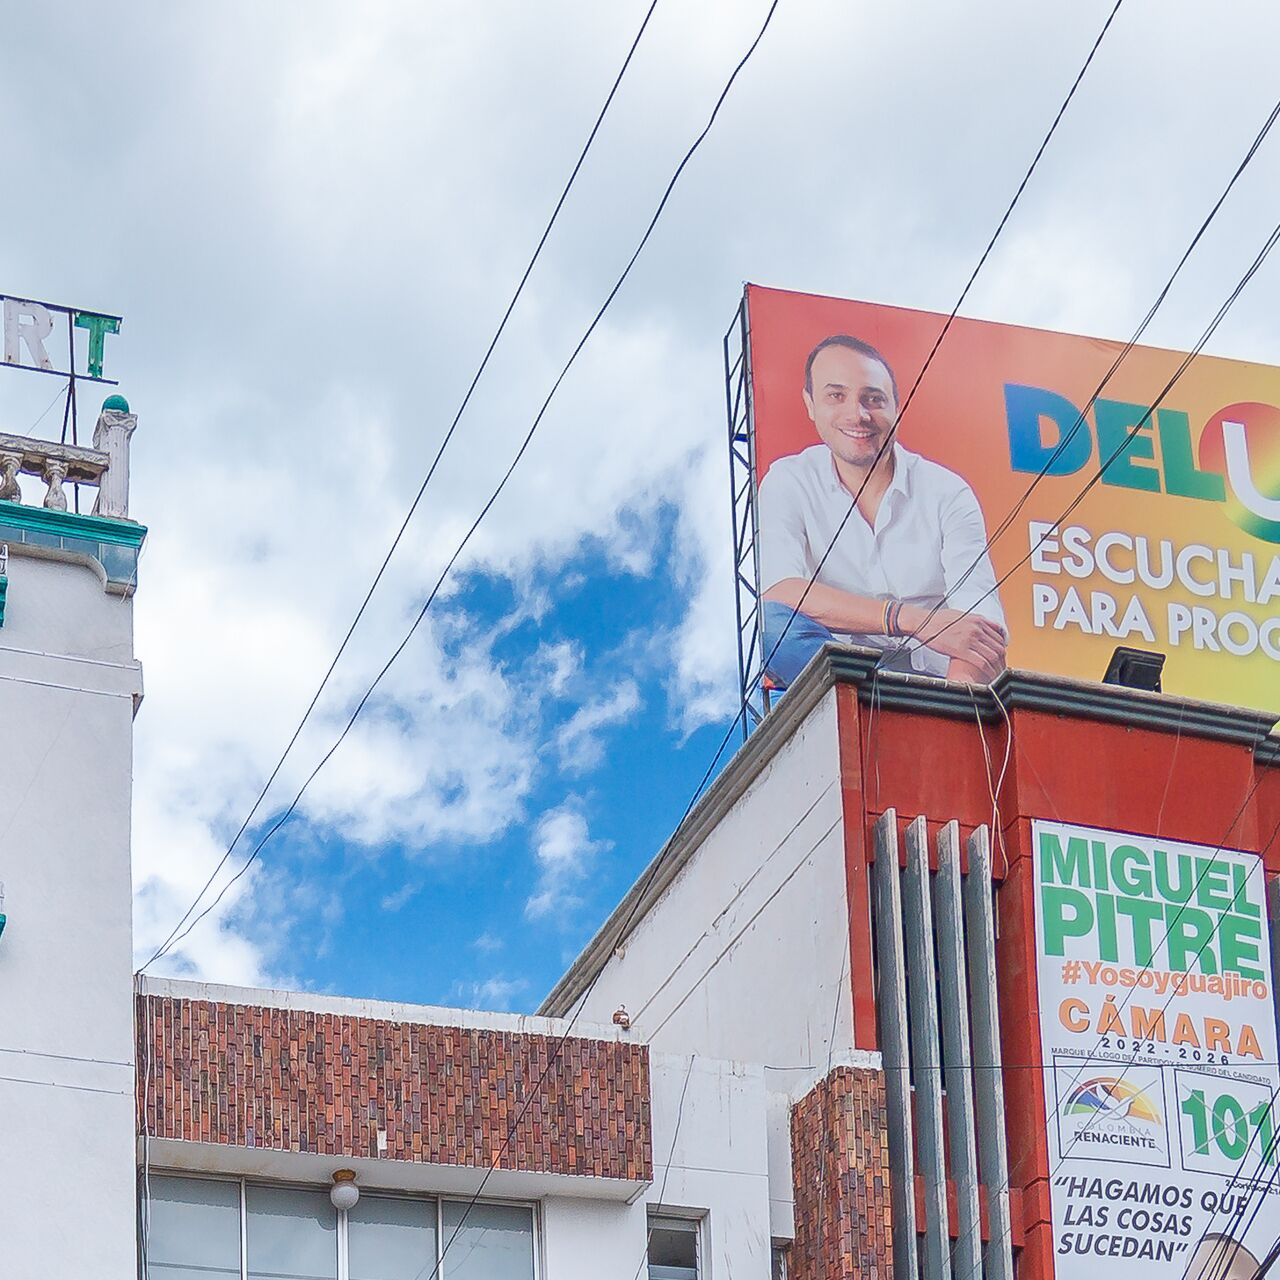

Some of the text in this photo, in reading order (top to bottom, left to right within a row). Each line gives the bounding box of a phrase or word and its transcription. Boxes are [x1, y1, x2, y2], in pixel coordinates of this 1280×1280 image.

[1031, 583, 1156, 645] PARA
[1039, 832, 1261, 919] MIGUEL
[1040, 885, 1266, 981] PITRE
[1061, 960, 1269, 1001] #Yosoyguajiro
[1058, 994, 1265, 1061] CÁMARA
[1102, 1037, 1230, 1066] 2022 2026
[1074, 1131, 1156, 1149] RENACIENTE
[1076, 1121, 1152, 1136] COLOMBIA
[1181, 1088, 1276, 1167] 101
[1063, 1204, 1193, 1237] LAS COSAS
[1201, 1190, 1249, 1217] QUE
